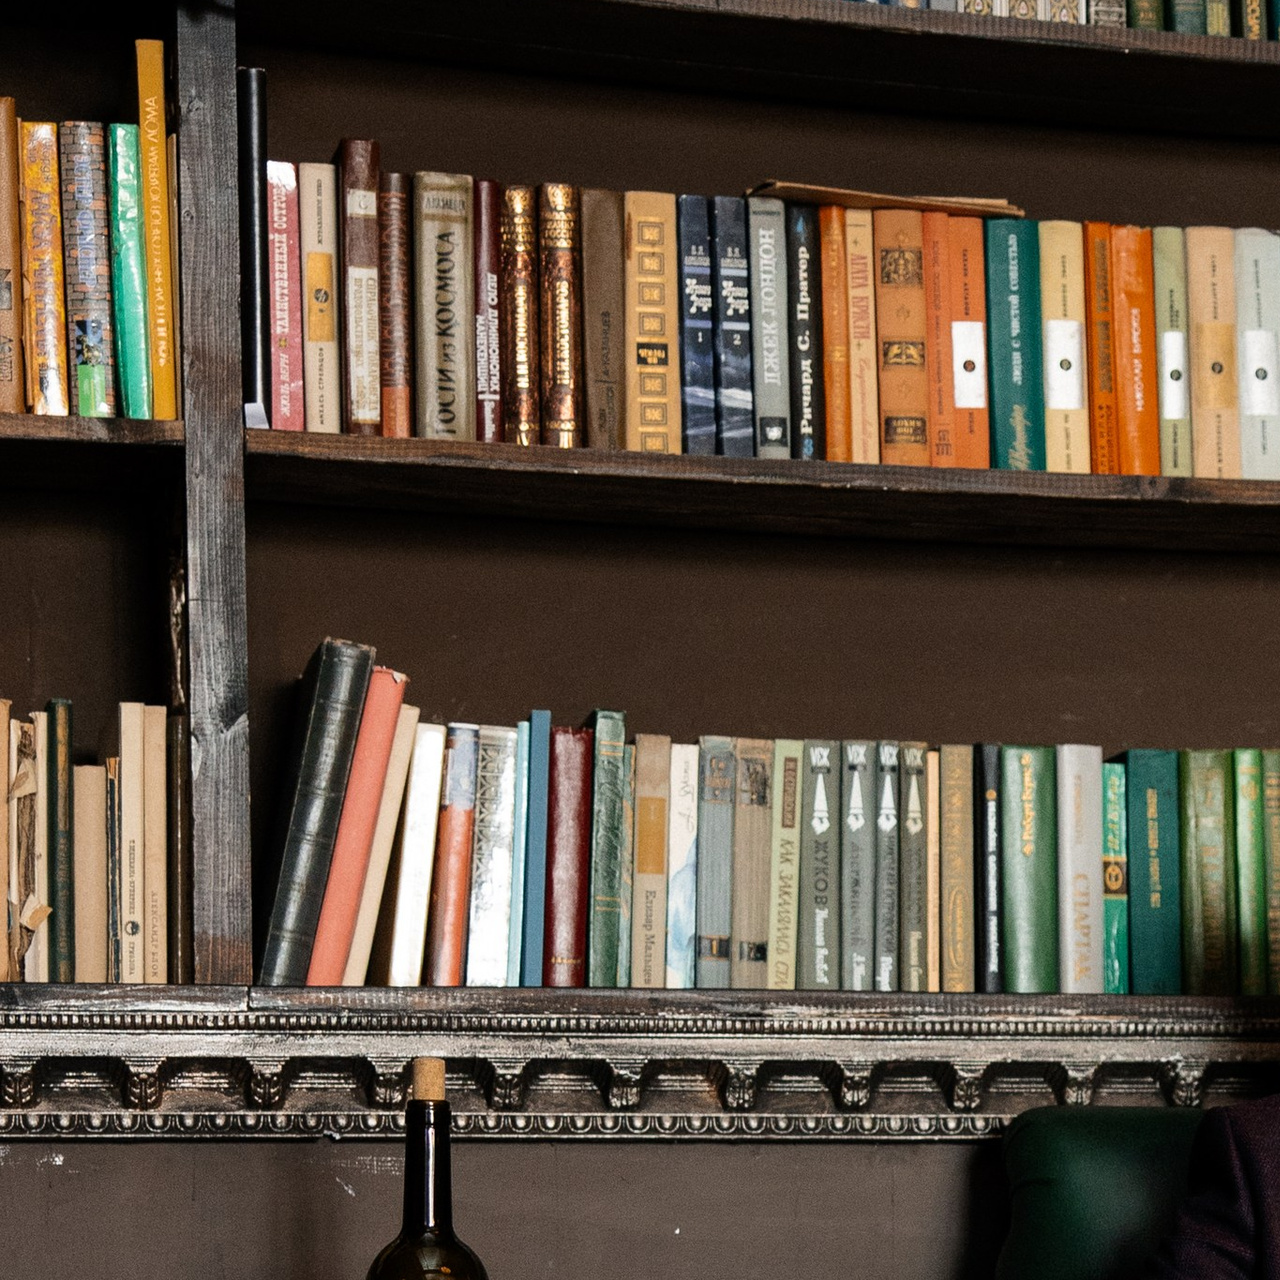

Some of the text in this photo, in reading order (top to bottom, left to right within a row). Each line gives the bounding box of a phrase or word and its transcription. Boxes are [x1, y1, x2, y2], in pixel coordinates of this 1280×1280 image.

[144, 96, 159, 142] ДОМА
[74, 155, 94, 207] ЭСТЕР
[272, 234, 290, 335] ТАИНСТВЕННЫЙ
[434, 231, 459, 338] КОСМОСА
[486, 273, 498, 305] ДЕЛО
[851, 253, 869, 290] АГАТА
[366, 277, 379, 343] СПРАВОЧНИК
[733, 334, 743, 346] 2
[758, 228, 782, 386] ДЖЕК ЛОНДОН
[851, 296, 870, 340] КРИСТИ
[277, 354, 291, 382] ВЕРН
[476, 315, 489, 392] МАНЕКЕНЩИЦ
[487, 309, 500, 392] ДЛИННОНОГИХ
[795, 246, 814, 436] Ричард С. Пратер
[434, 367, 457, 434] ГОСТИ
[779, 838, 796, 866] КАК
[814, 839, 829, 905] ЖУКОВ
[150, 891, 160, 979] АЛЕКСАНДР БЛОК
[642, 889, 657, 986] Елизар Мальцев
[776, 870, 795, 955] ЗАКАЛЯЛАСЬ
[1072, 872, 1093, 982] СПАРТАК
